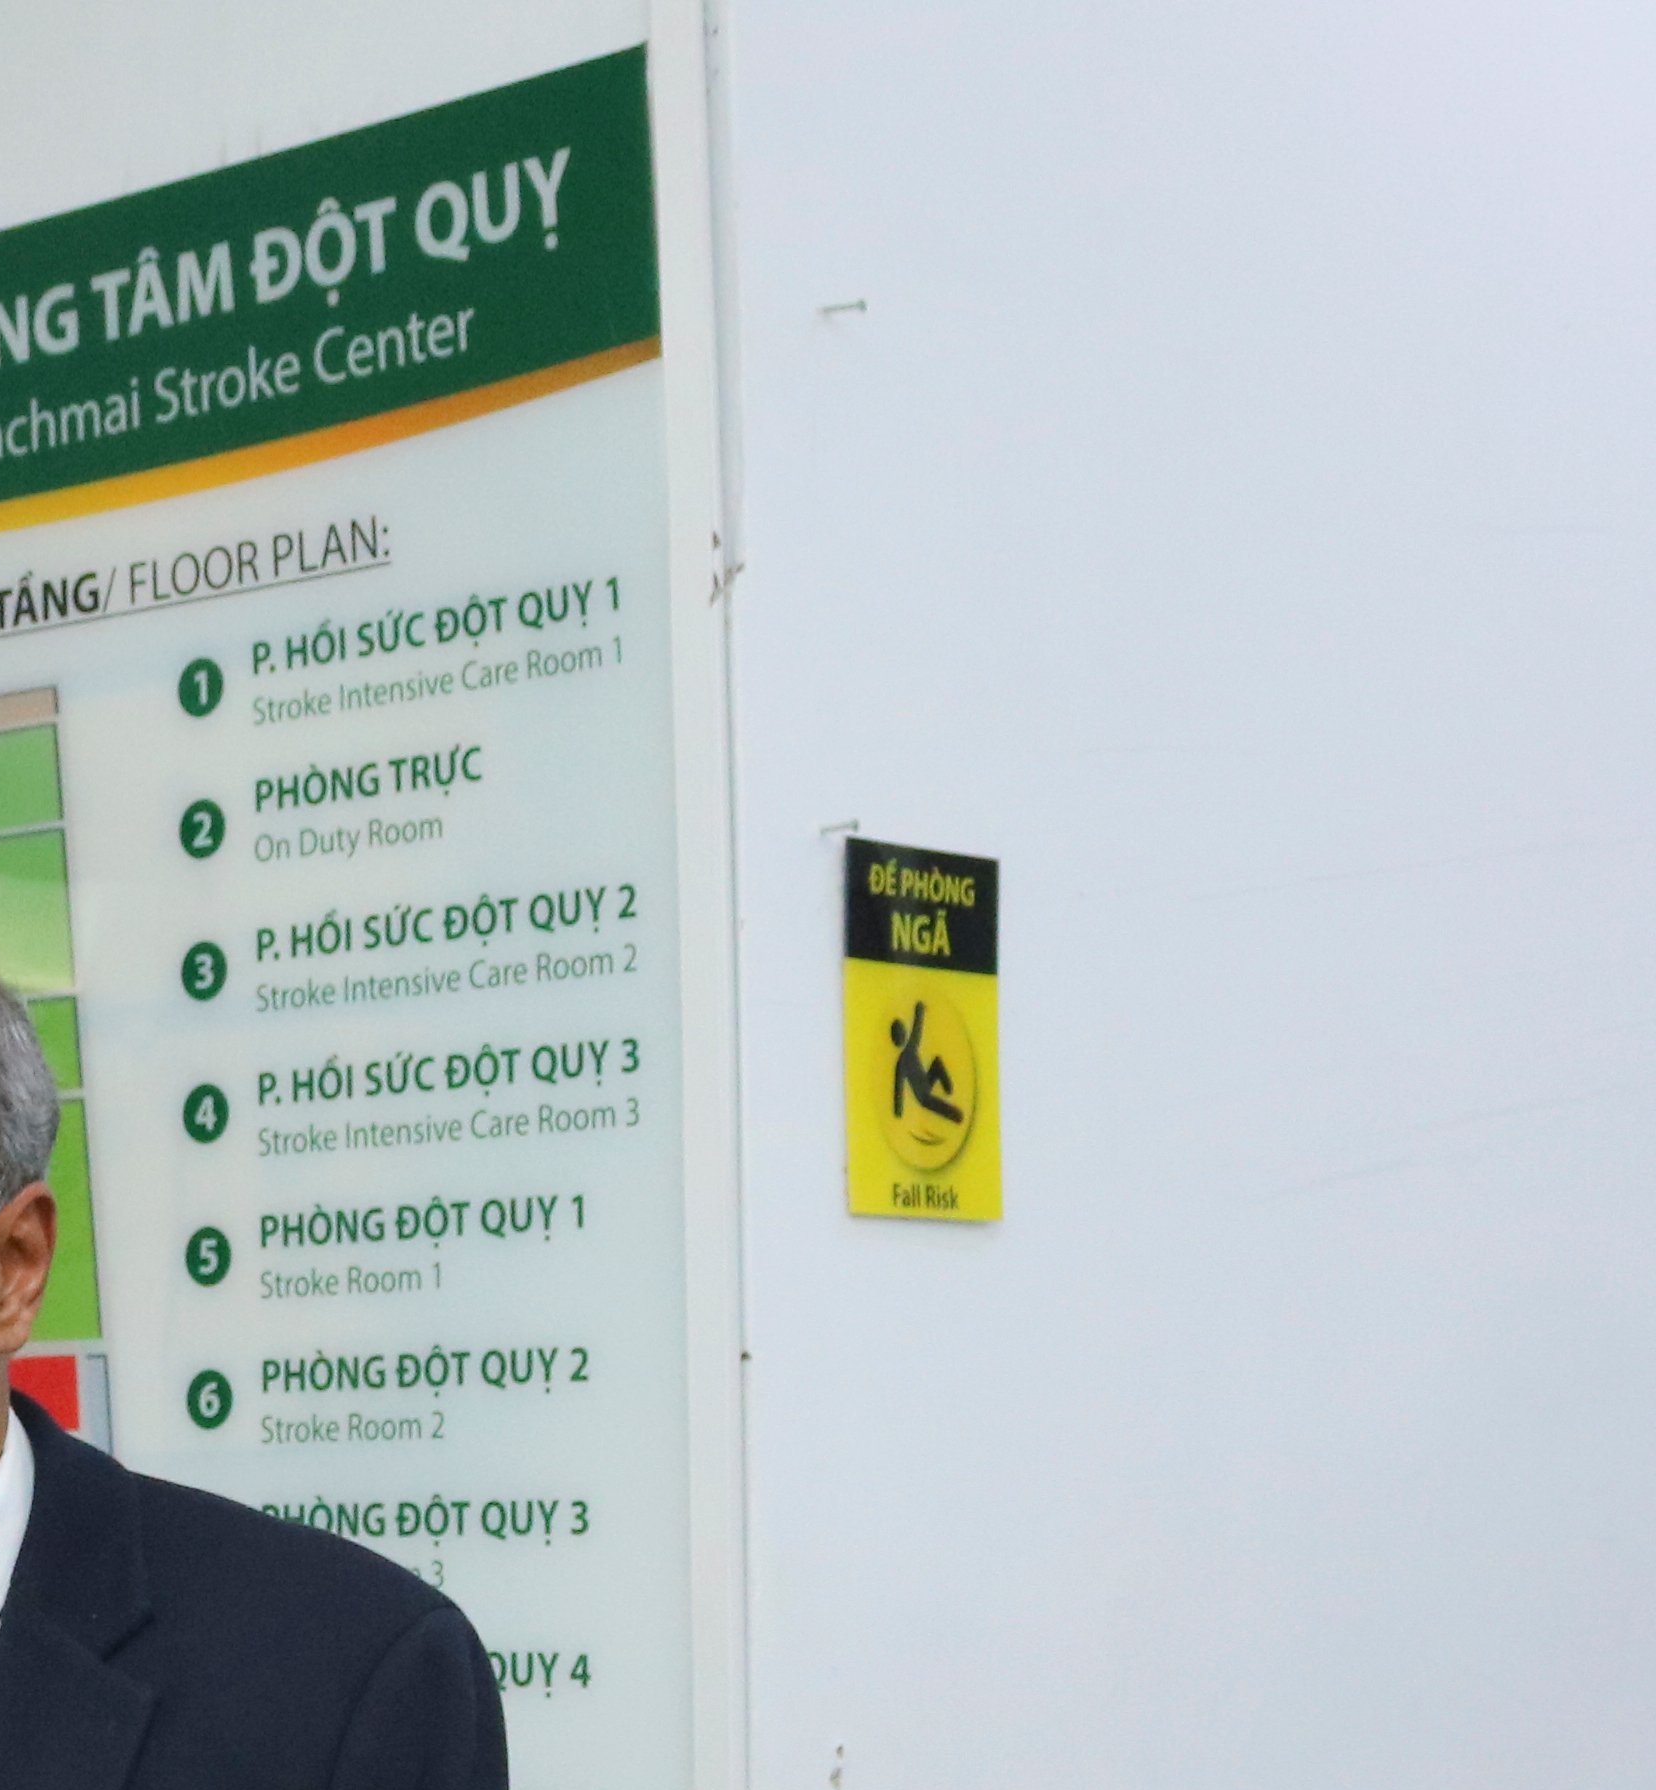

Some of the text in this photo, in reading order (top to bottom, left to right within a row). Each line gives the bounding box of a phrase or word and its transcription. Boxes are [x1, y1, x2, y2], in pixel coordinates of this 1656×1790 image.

[91, 244, 234, 340] TÂM
[250, 198, 395, 307] ĐỘT
[416, 150, 570, 261] QUỴ
[156, 346, 299, 423] Stroke
[315, 308, 475, 387] Center
[129, 541, 258, 604] FLOOR
[272, 515, 389, 577] PLAN:
[252, 640, 275, 675] P.
[356, 609, 426, 657] SỨC
[434, 593, 508, 647] ĐỘT
[517, 580, 592, 630] QUỴ
[606, 577, 619, 611] 1
[195, 671, 208, 704] 1
[252, 635, 622, 726] Stroke Intensive Care Room 1
[255, 744, 482, 813] PHÒNG TRỰC
[193, 812, 212, 847] 2
[254, 817, 443, 862] On Duty Room
[900, 867, 974, 906] PHÒNG
[256, 928, 280, 962] P.
[363, 905, 433, 950] SỨC
[443, 893, 519, 946] ĐỘT
[528, 886, 606, 933] QUỴ
[618, 883, 637, 920] 2
[196, 954, 214, 989] 3
[256, 943, 637, 1013] Stroke Intensive Care Room 2
[258, 1072, 282, 1105] P.
[365, 1052, 435, 1097] SỨC
[444, 1044, 521, 1096] ĐỘT
[531, 1040, 609, 1086] QUỴ
[622, 1038, 640, 1073] 3
[195, 1096, 217, 1130] 4
[258, 1096, 640, 1157] Stroke Intensive Care Room 3
[893, 1183, 959, 1210] Fall Risk
[260, 1194, 584, 1248] PHÒNG ĐỘT QUỴ 1
[200, 1239, 218, 1275] 5
[260, 1262, 441, 1299] Stroke Room 1
[262, 1344, 589, 1398] PHÒNG ĐỘT QUỴ 2
[199, 1382, 220, 1417] 6
[261, 1409, 445, 1444] Stroke Room 2
[394, 1494, 471, 1546] ĐỘT
[481, 1500, 559, 1545] QUỴ
[571, 1500, 589, 1535] 3
[429, 1560, 444, 1589] 3
[570, 1654, 591, 1688] 4
